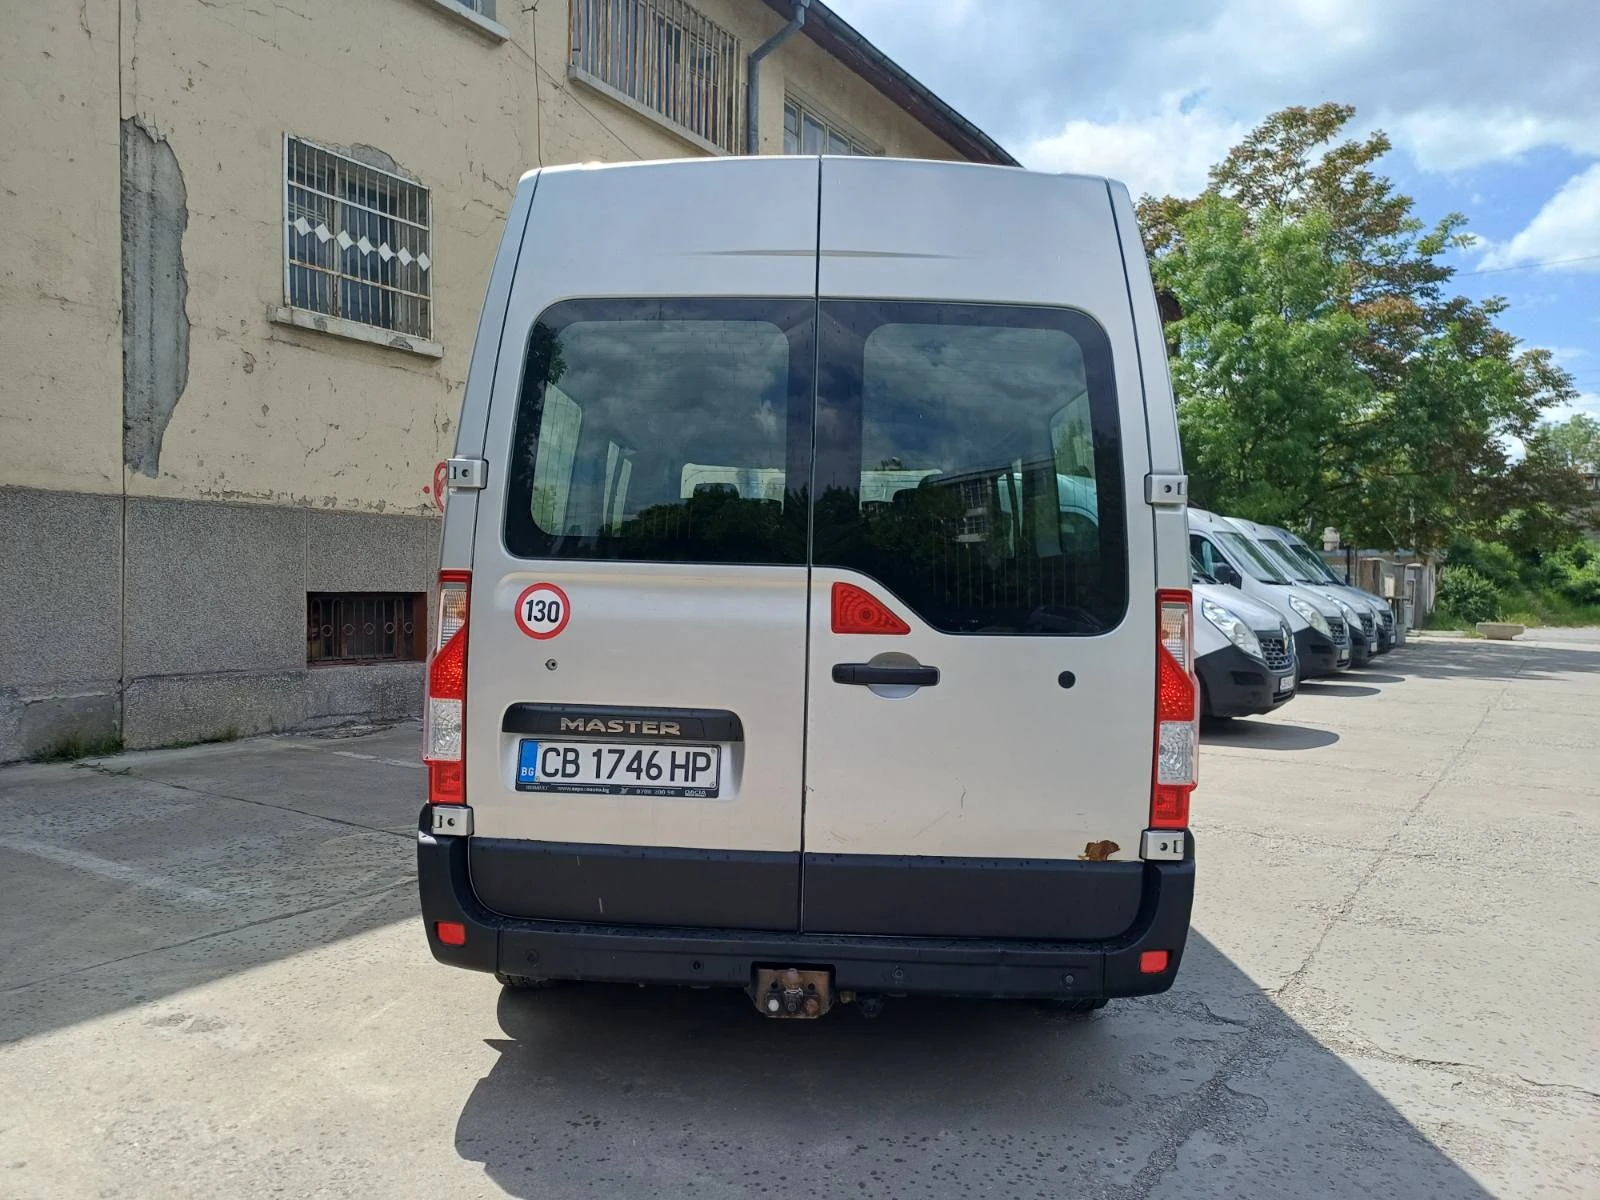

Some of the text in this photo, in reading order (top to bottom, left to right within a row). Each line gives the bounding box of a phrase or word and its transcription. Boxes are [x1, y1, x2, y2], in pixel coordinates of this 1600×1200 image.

[525, 599, 560, 623] 130
[560, 717, 681, 735] MASTER
[521, 766, 535, 776] BG
[541, 747, 712, 783] CB 1746 HP
